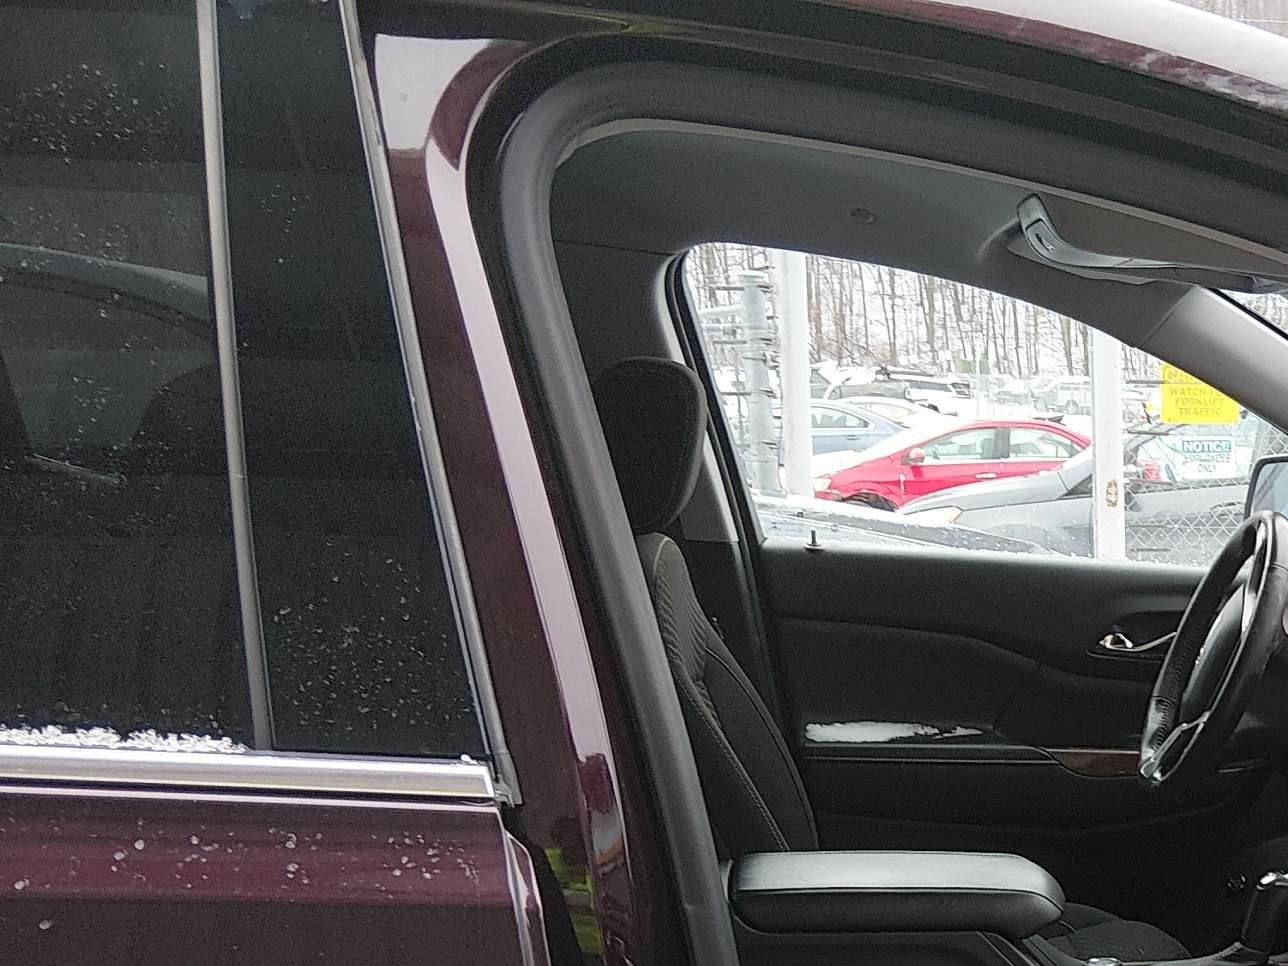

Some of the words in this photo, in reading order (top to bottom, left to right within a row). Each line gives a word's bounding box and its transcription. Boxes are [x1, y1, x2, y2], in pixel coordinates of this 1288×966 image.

[1169, 386, 1206, 396] WATCH
[1175, 397, 1224, 406] FORKLIFT
[1178, 407, 1221, 416] TRAFFIC
[1183, 441, 1231, 453] NOTICE
[1198, 464, 1216, 473] ONLY
